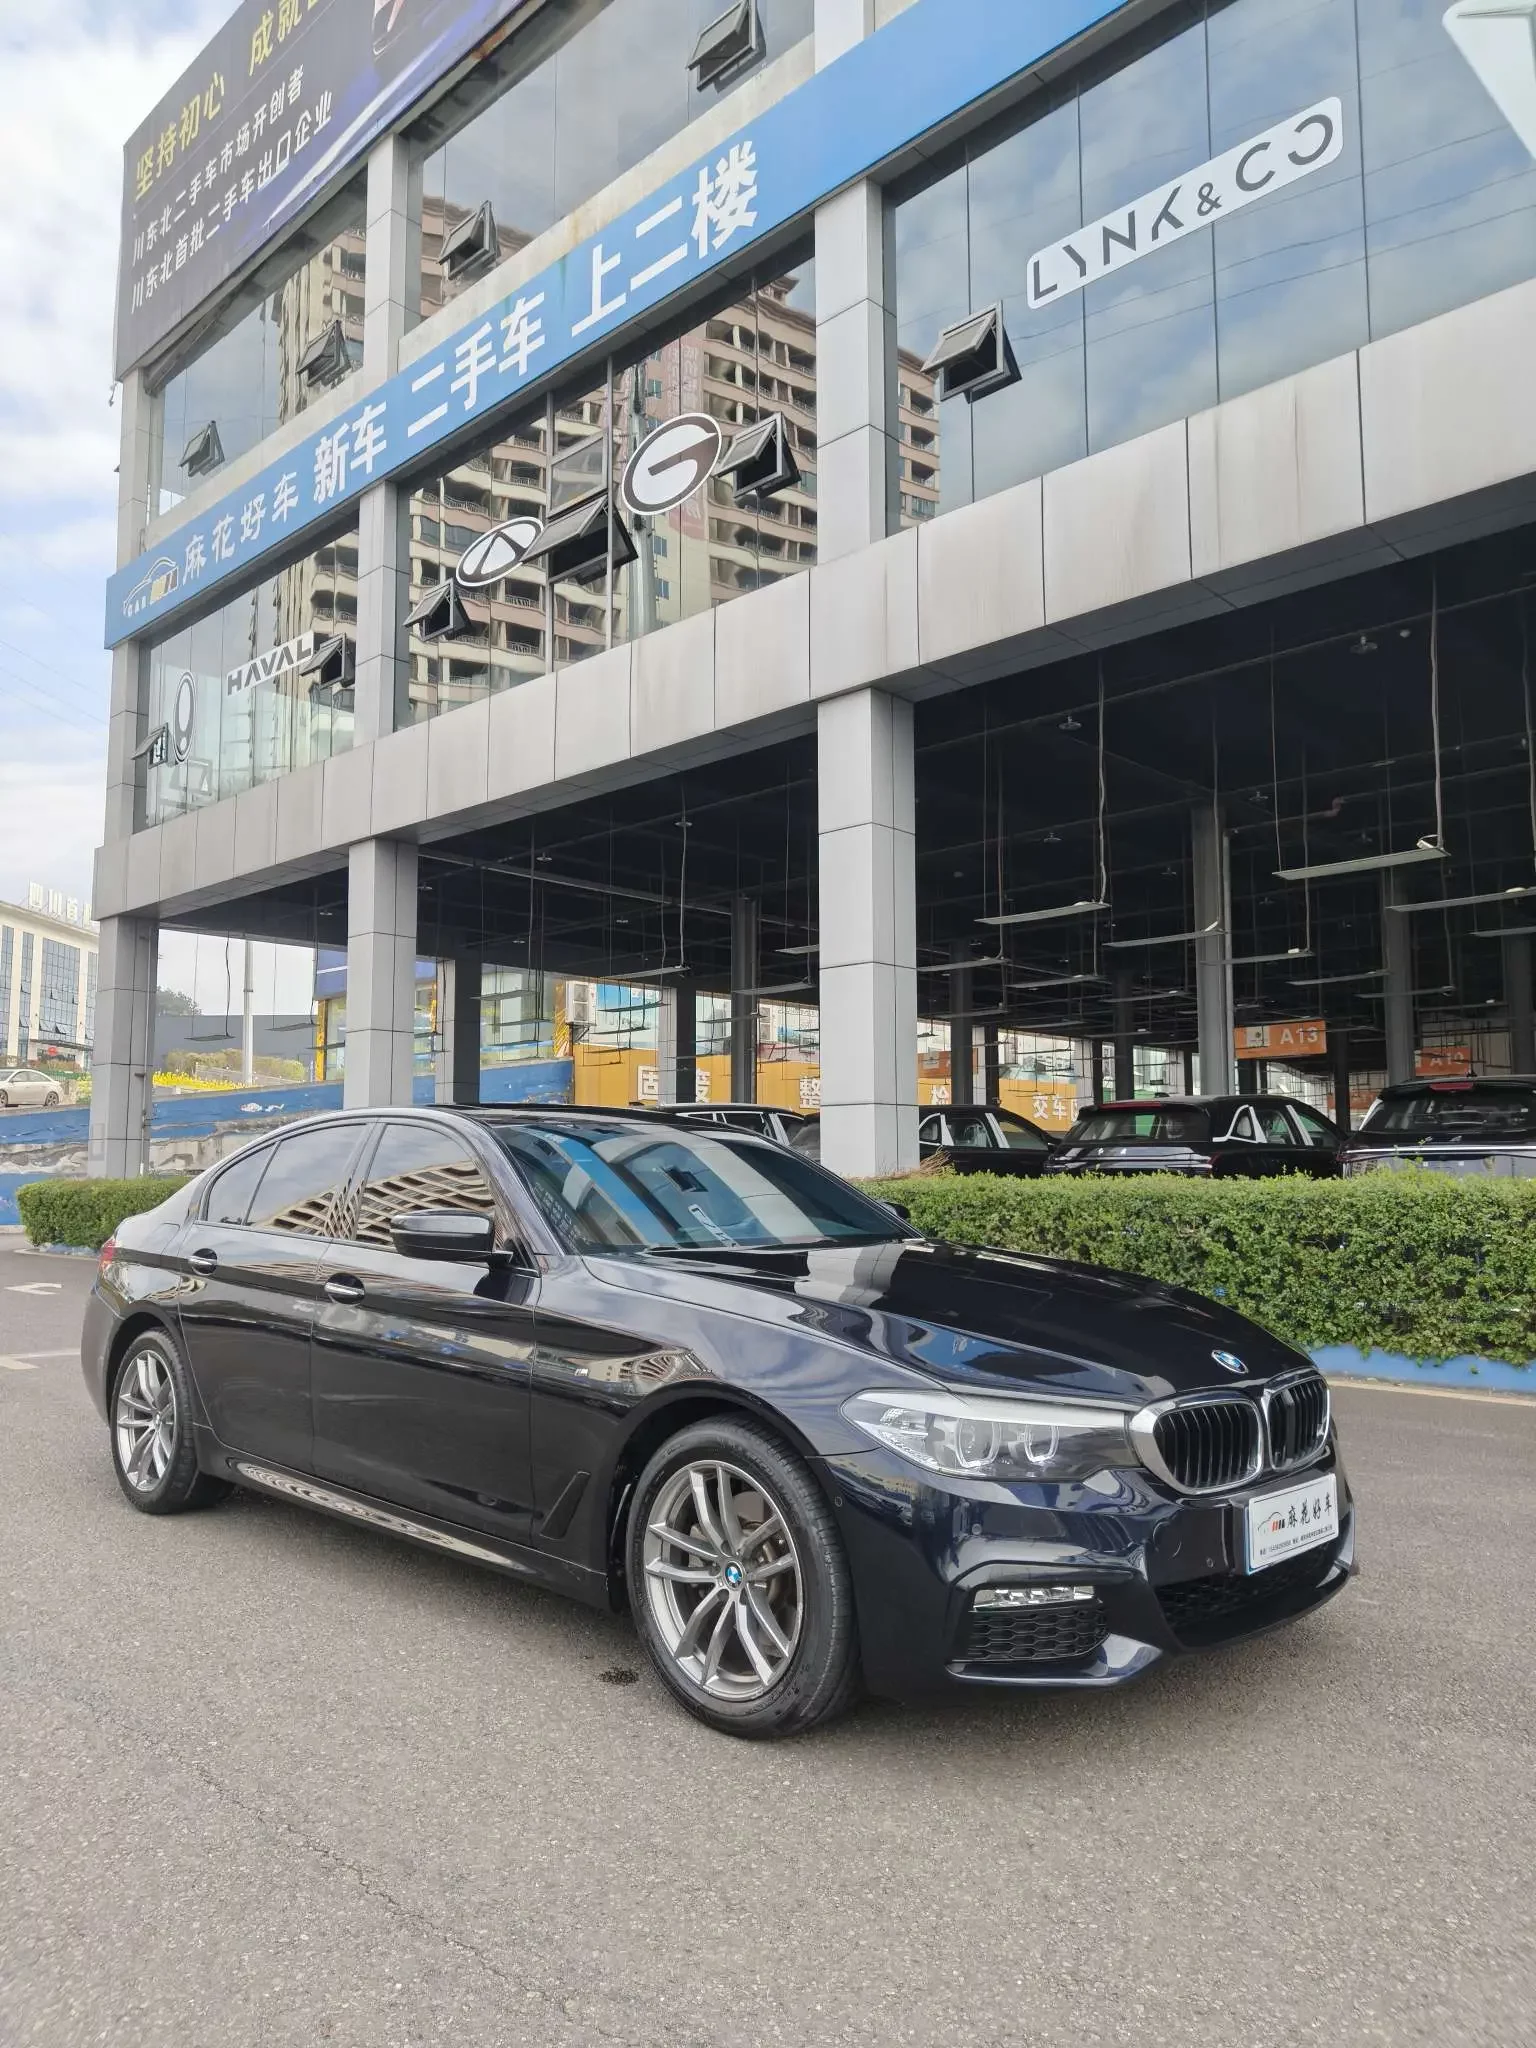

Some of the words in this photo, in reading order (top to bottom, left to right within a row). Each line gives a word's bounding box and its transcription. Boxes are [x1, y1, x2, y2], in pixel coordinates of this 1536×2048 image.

[132, 64, 304, 267] 川东北二手车市场开创者
[135, 71, 225, 202] 坚持初心
[249, 0, 319, 77] 成就
[131, 90, 333, 315] 川东北首批二手车出口企业
[182, 471, 298, 586] 麻花好车
[313, 401, 388, 503] 新车
[408, 292, 546, 438] 二手车
[571, 140, 759, 338] 上二楼
[227, 636, 313, 697] HAVAL
[1280, 1026, 1318, 1045] A13
[1287, 1491, 1332, 1528] 麻花好车
